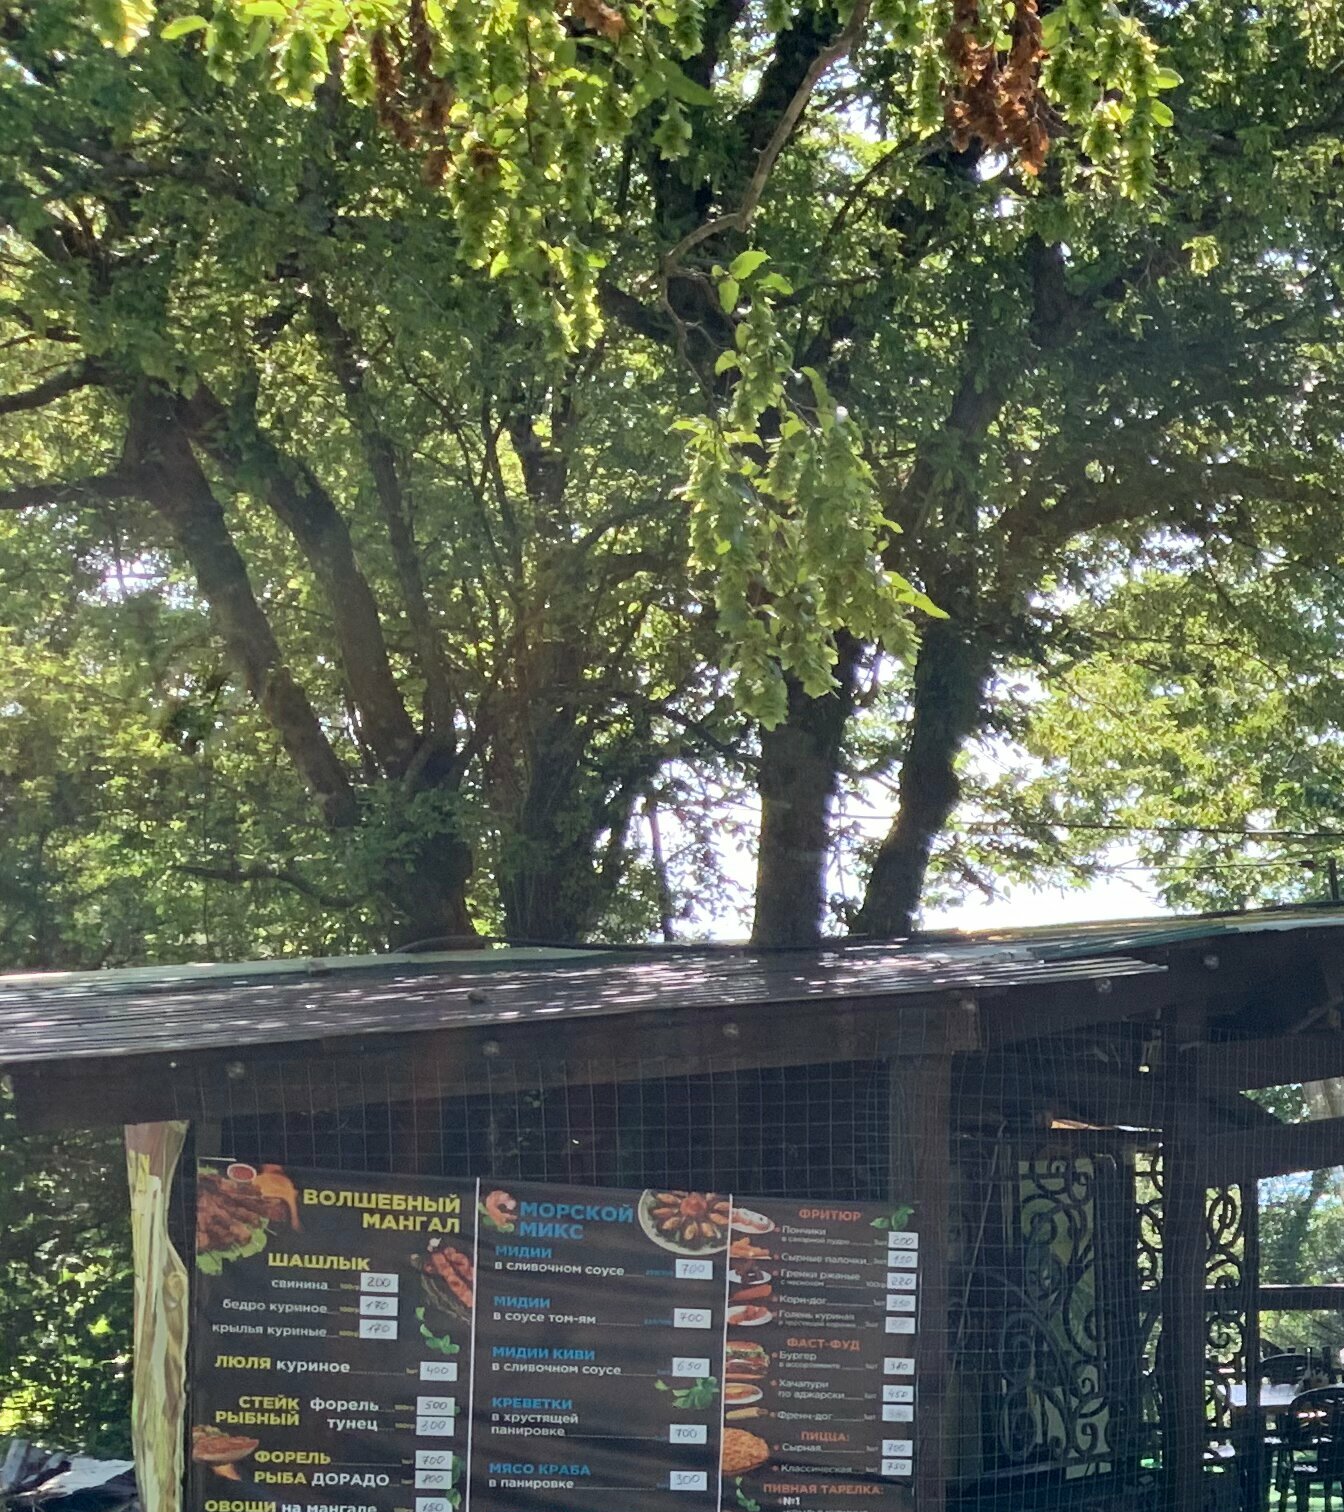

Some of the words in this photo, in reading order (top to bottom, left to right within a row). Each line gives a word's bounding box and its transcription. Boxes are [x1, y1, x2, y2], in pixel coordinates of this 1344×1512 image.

[303, 1189, 461, 1212] ВОЛШЕБНЫЙ
[520, 1202, 633, 1223] МОРСКОЙ
[799, 1207, 861, 1222] ФРИТЮР
[362, 1213, 460, 1233] МАНГАЛ
[520, 1223, 583, 1239] МИКС
[495, 1246, 552, 1258] МИДИИ
[268, 1253, 370, 1270] ШАШЛЫК
[495, 1262, 502, 1270] в
[507, 1262, 581, 1273] сливочном
[585, 1266, 624, 1277] соусе
[271, 1278, 328, 1290] свинина
[368, 1277, 390, 1287] 200
[223, 1299, 266, 1312] бедро
[270, 1302, 327, 1315] куриное
[494, 1296, 550, 1309] МИДИИ
[493, 1312, 501, 1320] в
[505, 1313, 544, 1323] соусе
[548, 1314, 596, 1324] том-ям
[212, 1323, 263, 1335] крылья
[267, 1325, 327, 1338] куриные
[787, 1338, 860, 1350] ФАСТ-ФУД
[492, 1347, 549, 1359] МИДИИ
[553, 1349, 595, 1360] КИВИ
[779, 1351, 817, 1361] Бургер
[215, 1354, 271, 1369] ЛЮЛЯ
[276, 1359, 350, 1374] куриное
[427, 1366, 449, 1376] 400
[492, 1363, 499, 1371] в
[504, 1363, 578, 1374] сливочном
[582, 1366, 621, 1377] соусе
[779, 1380, 829, 1390] Хачапури
[239, 1394, 299, 1410] СТЕЙК
[310, 1397, 379, 1413] форель
[425, 1401, 448, 1410] 500
[492, 1397, 573, 1410] КРЕВЕТКИ
[215, 1411, 299, 1426] РЫБНЫЙ
[327, 1417, 378, 1432] тунец
[492, 1413, 499, 1421] в
[504, 1413, 579, 1425] хрустящей
[491, 1426, 565, 1437] панировке
[782, 1443, 822, 1452] Сырная
[255, 1449, 331, 1464] ФОРЕЛЬ
[489, 1463, 534, 1474] МЯСО
[539, 1464, 591, 1475] КРАБА
[254, 1472, 307, 1484] РЫБА
[312, 1473, 389, 1487] ДОРАДО
[489, 1480, 496, 1488] в
[501, 1480, 574, 1490] панировке
[763, 1484, 817, 1494] ПИВНАЯ
